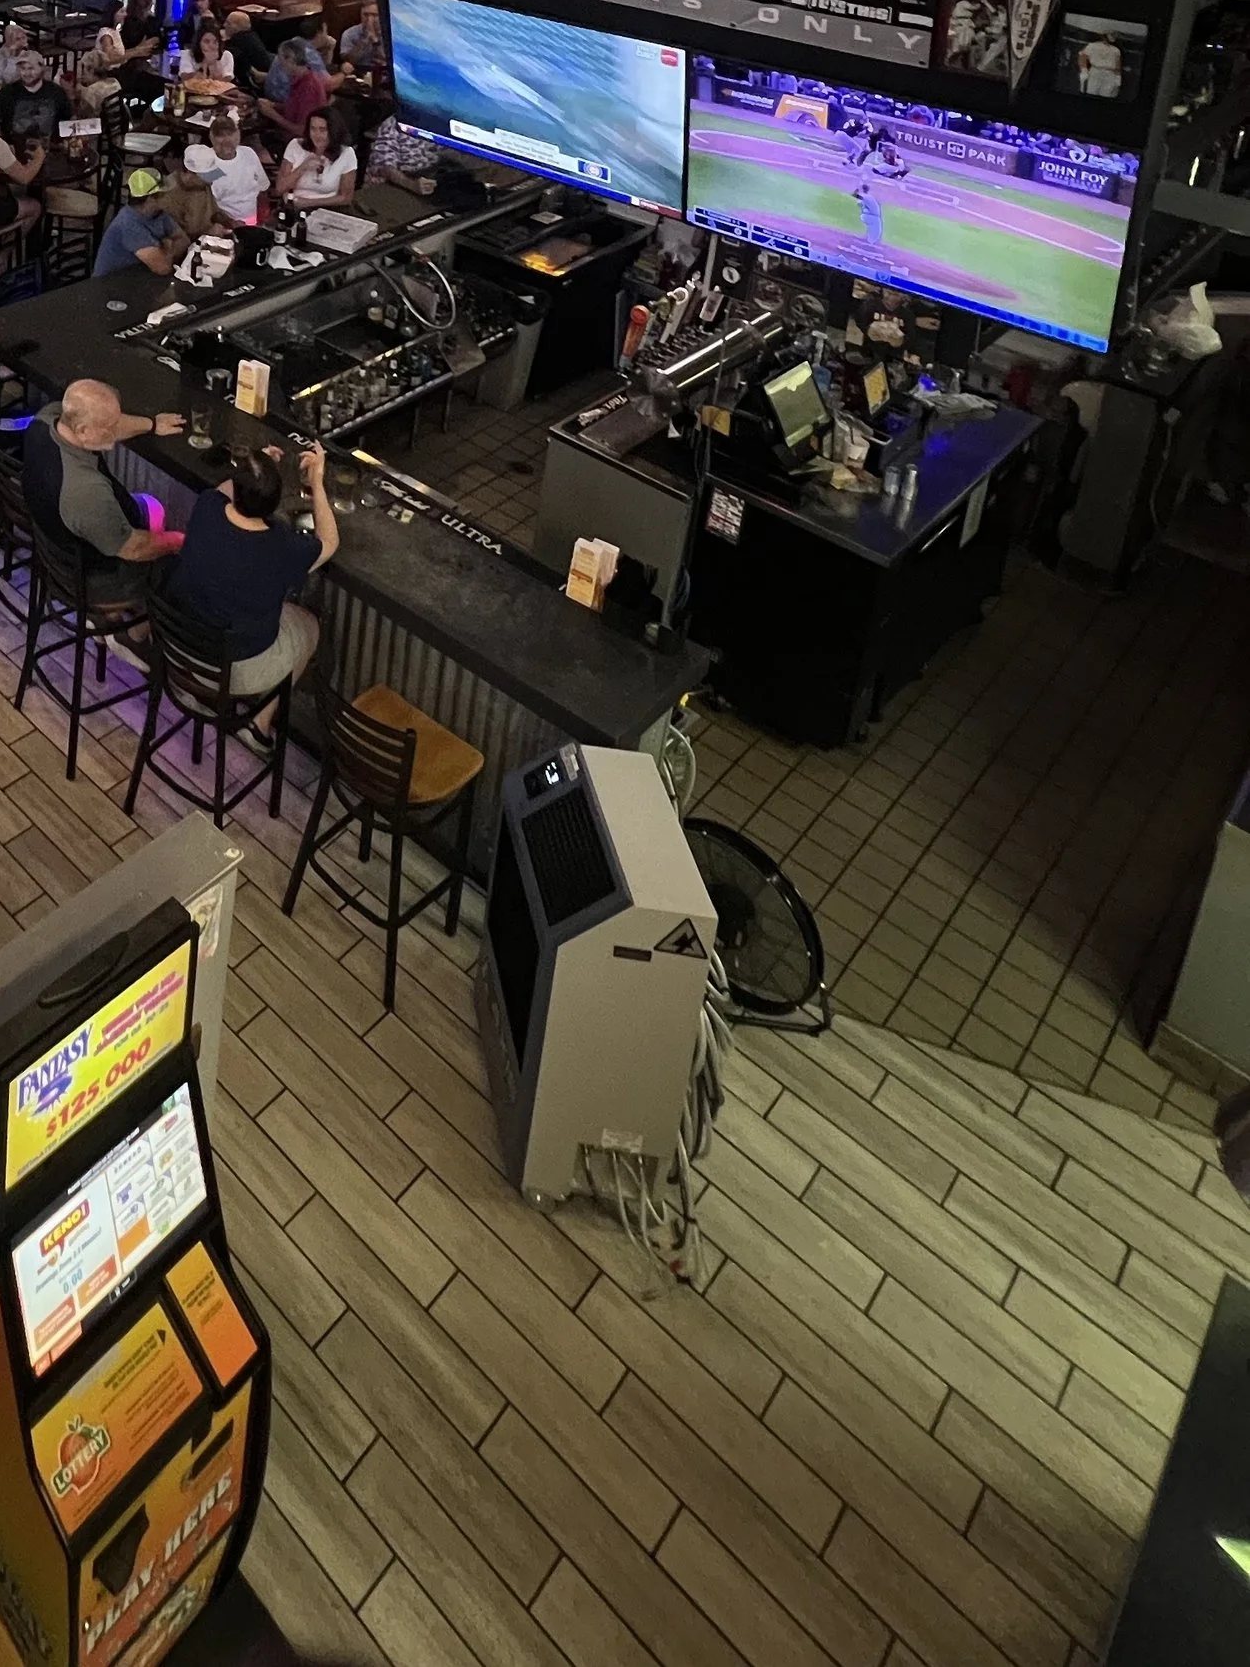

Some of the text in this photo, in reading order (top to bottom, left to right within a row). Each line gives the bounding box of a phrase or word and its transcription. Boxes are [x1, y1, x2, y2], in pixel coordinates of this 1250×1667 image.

[756, 6, 922, 52] ONLY
[896, 130, 1007, 168] TRUIST PARK
[1038, 160, 1077, 180] JOHN
[1080, 170, 1110, 187] FOY
[440, 513, 503, 556] ULTRA
[18, 1024, 93, 1112] FANTASY
[43, 1201, 88, 1250] KENO!
[53, 1428, 106, 1492] LOTTERY
